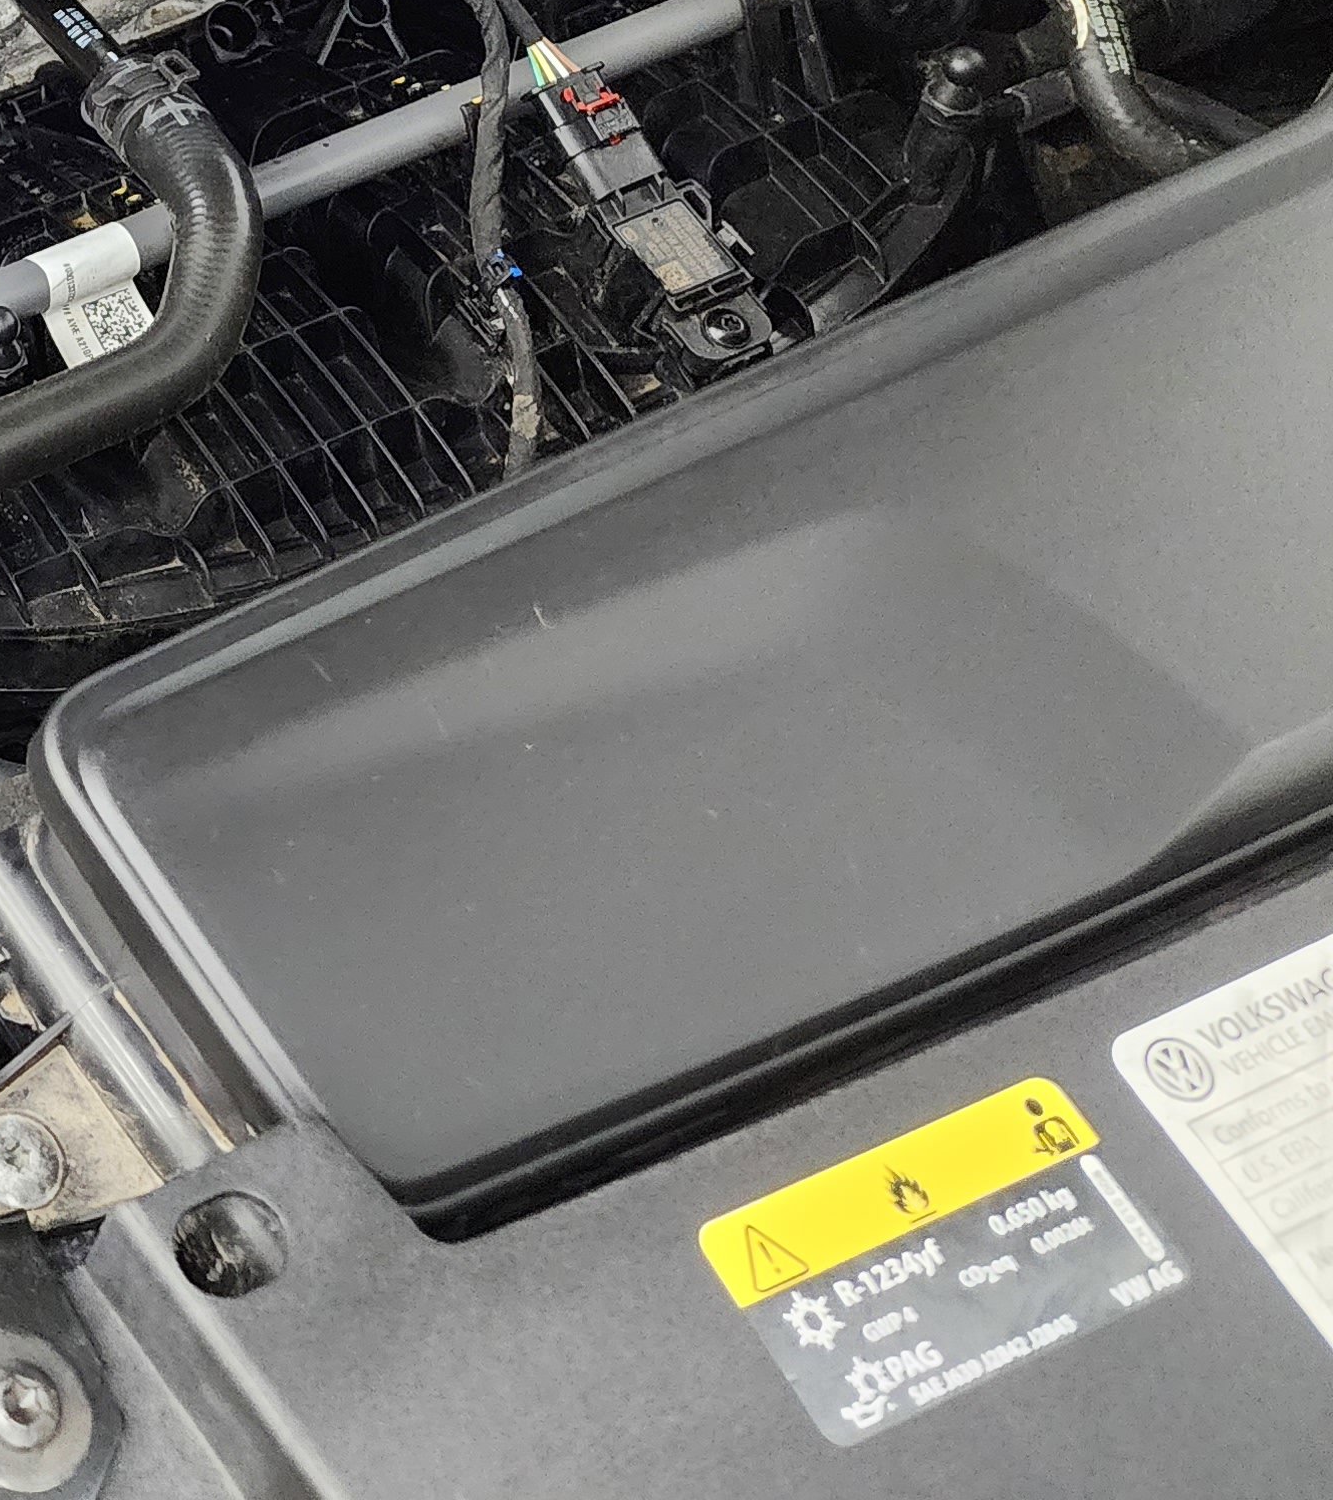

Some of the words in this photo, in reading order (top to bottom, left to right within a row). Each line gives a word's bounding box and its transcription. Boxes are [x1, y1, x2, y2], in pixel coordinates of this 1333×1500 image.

[1221, 1025, 1306, 1076] VEHICLE
[1214, 1094, 1308, 1145] Conforms
[1284, 1136, 1321, 1165] EPA
[834, 1237, 946, 1307] R-1234yf
[988, 1196, 1046, 1238] 0.650
[1041, 1184, 1078, 1218] kg
[889, 1342, 941, 1382] PAG
[1111, 1277, 1149, 1307] VW
[1149, 1260, 1184, 1288] AG
